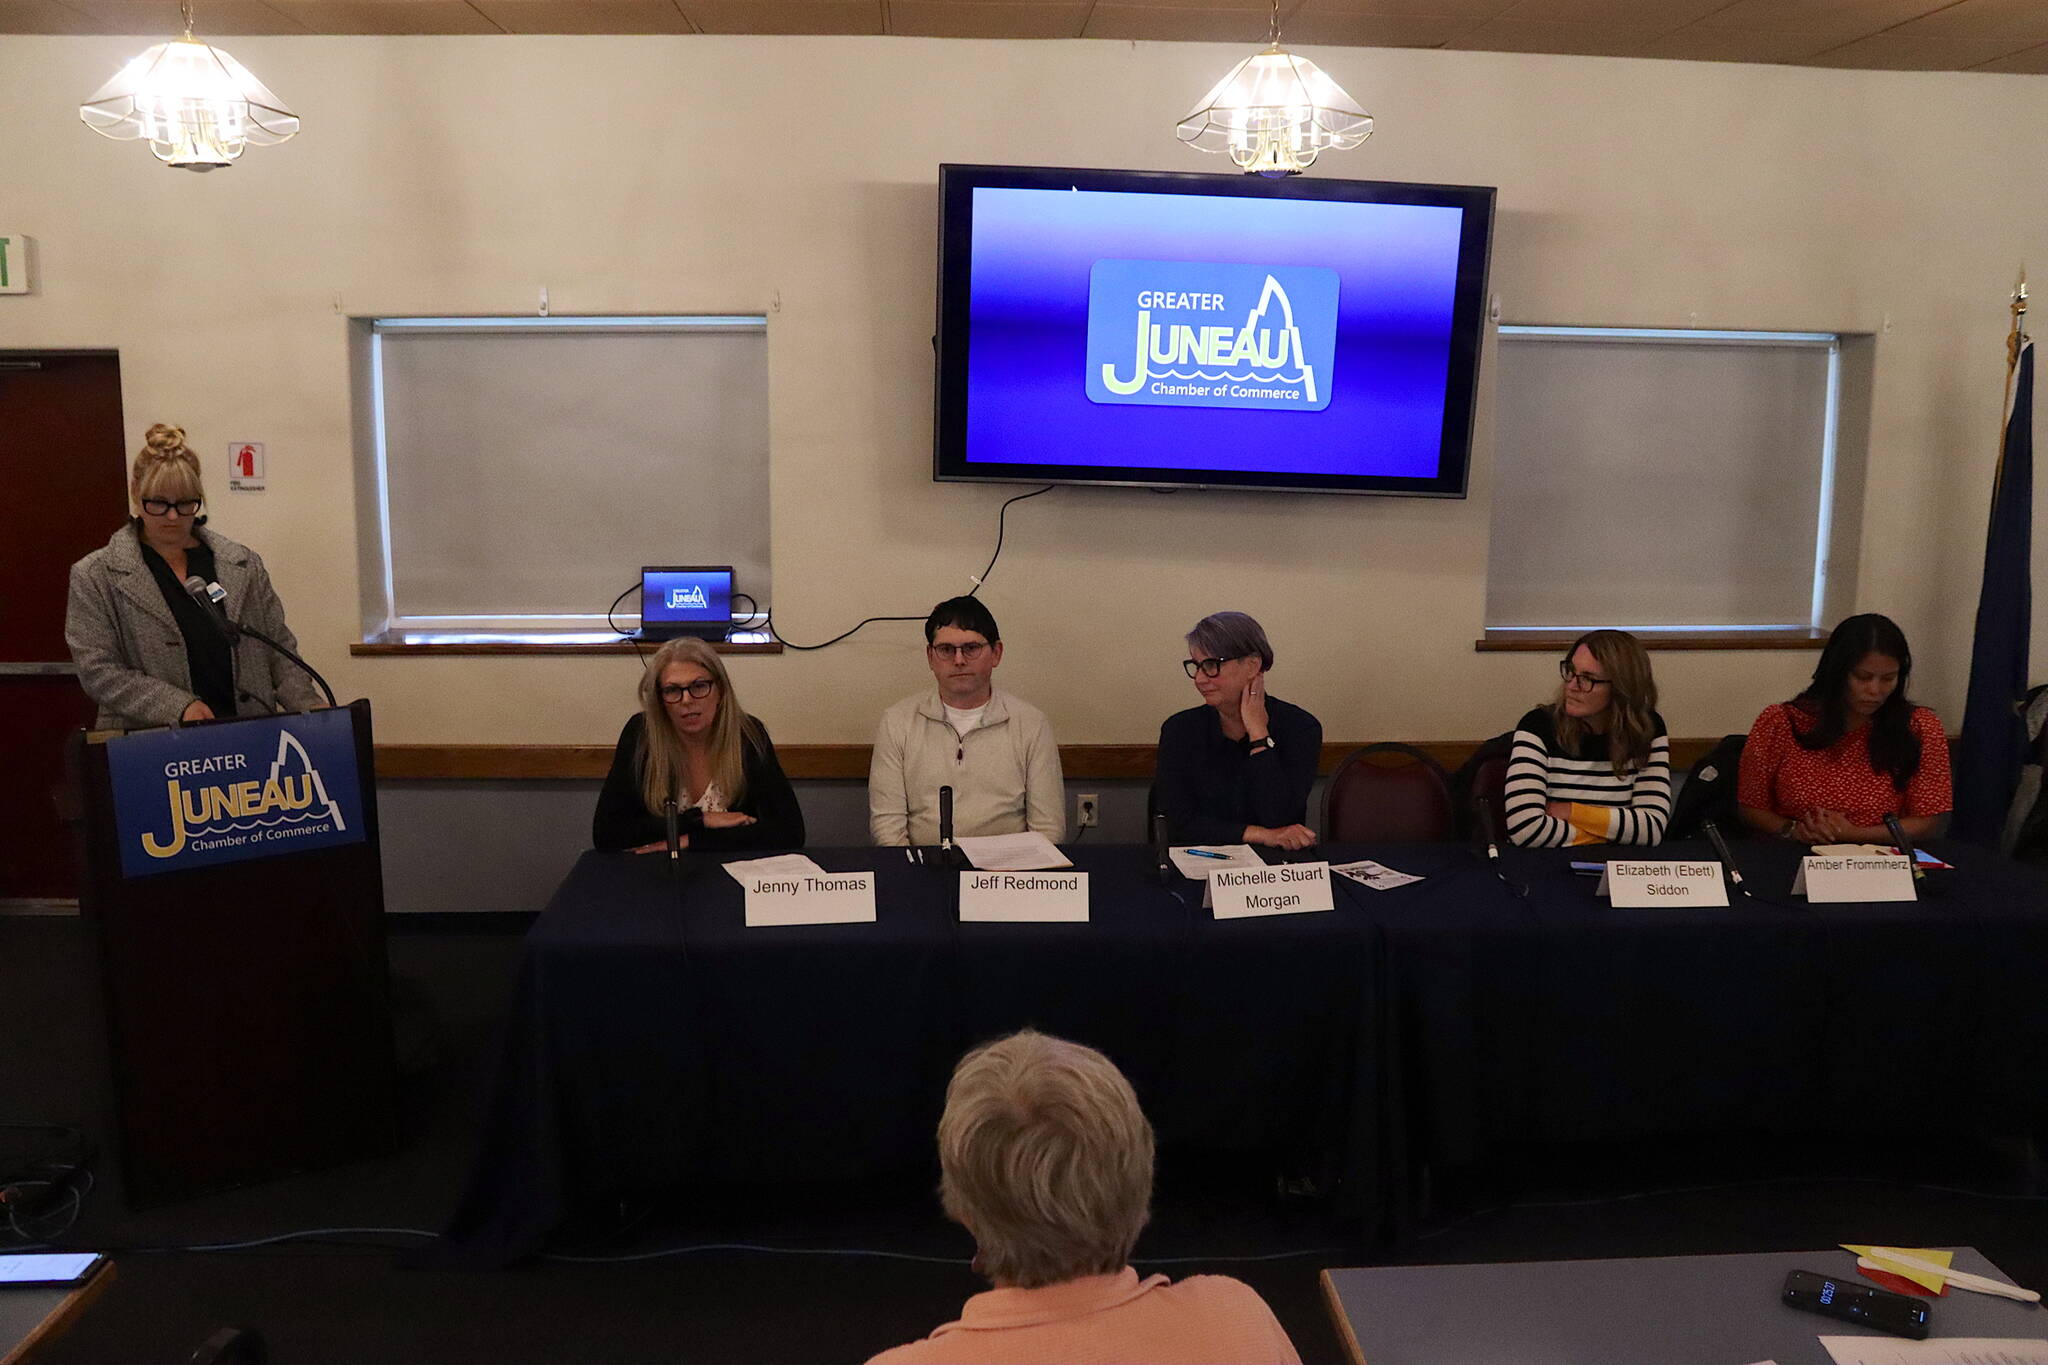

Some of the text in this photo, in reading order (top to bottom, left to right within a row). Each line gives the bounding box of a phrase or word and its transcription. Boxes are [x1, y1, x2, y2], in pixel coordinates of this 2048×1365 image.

[1137, 290, 1225, 311] GREATER
[1102, 310, 1290, 395] JUNEAU
[1151, 382, 1300, 400] Chamber of Commerce
[164, 754, 247, 778] GREATER
[141, 773, 313, 858] JUNEAU
[191, 822, 330, 852] Chamber of Commerce
[1616, 864, 1715, 878] Elizabeth (Ebett)
[1807, 859, 1909, 870] Amber Frommherz
[971, 876, 1078, 890] Jeff Redmond
[1217, 870, 1276, 887] Michelle
[1280, 867, 1324, 883] Stuart
[753, 878, 867, 896] Jenny Thomas
[1647, 884, 1689, 896] Siddon
[1245, 893, 1301, 910] Morgan
